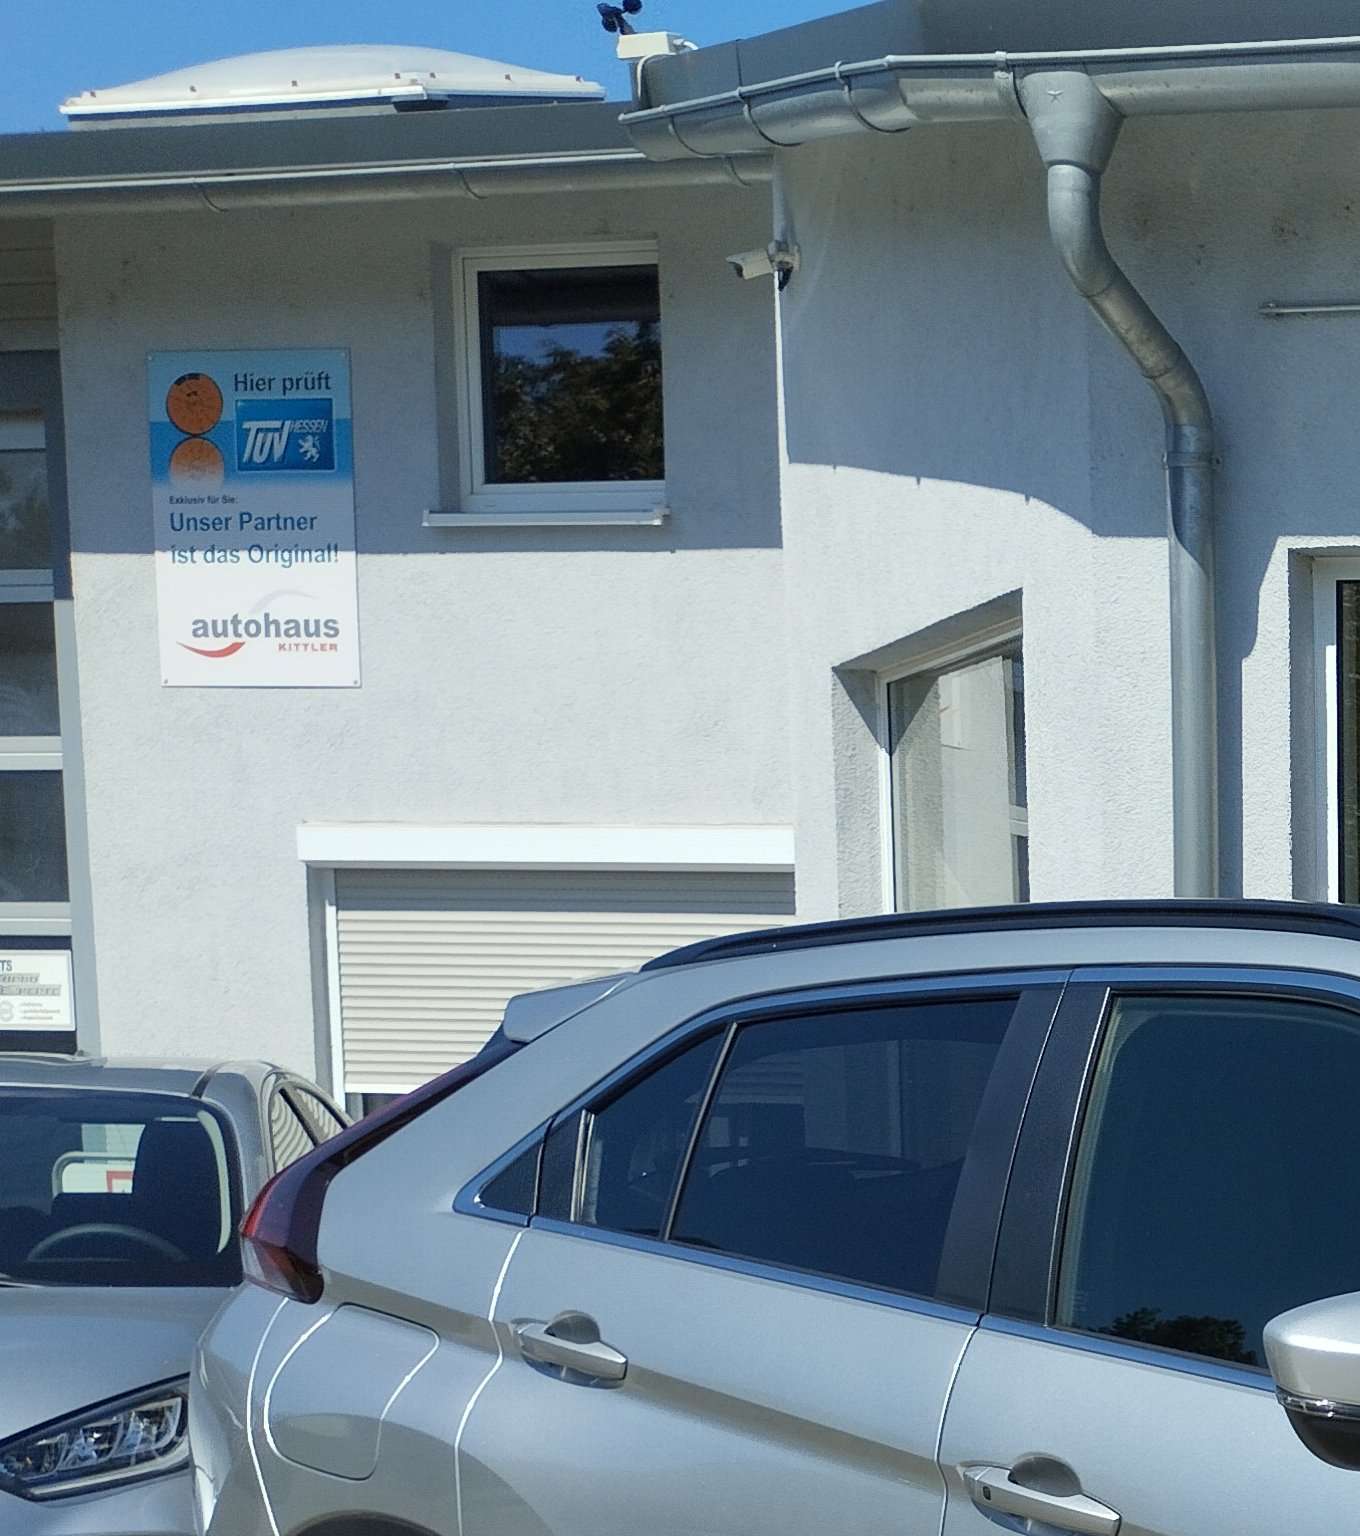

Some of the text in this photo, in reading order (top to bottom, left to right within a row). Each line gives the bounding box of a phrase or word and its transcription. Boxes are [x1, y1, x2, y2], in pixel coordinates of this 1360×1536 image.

[233, 371, 332, 397] Hier prüft
[290, 419, 328, 433] HESSEN
[169, 511, 318, 532] Unser Partner
[170, 543, 339, 568] ist das Original!
[190, 612, 341, 639] autohaus
[277, 642, 339, 653] KITTLER
